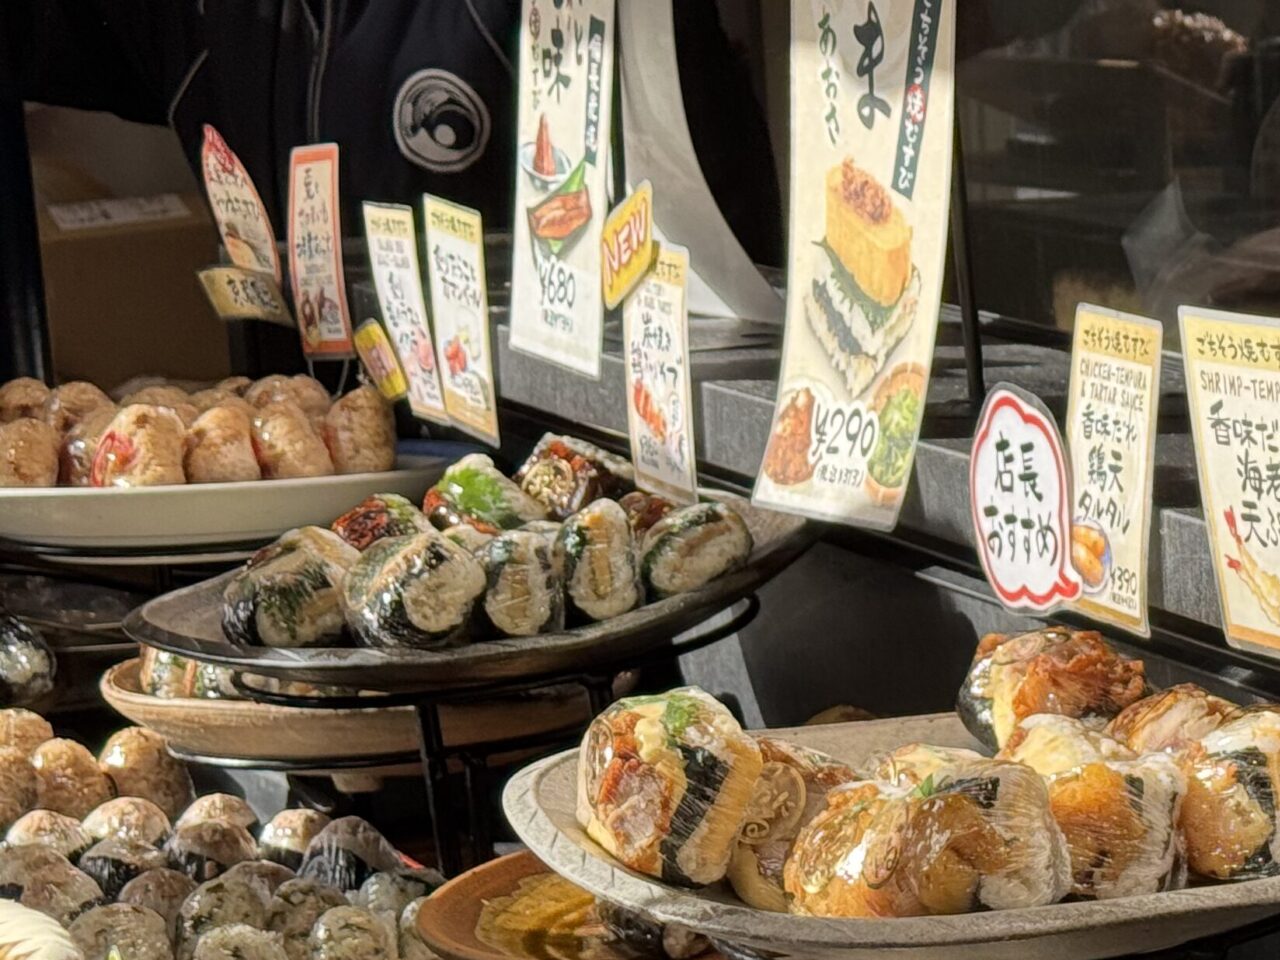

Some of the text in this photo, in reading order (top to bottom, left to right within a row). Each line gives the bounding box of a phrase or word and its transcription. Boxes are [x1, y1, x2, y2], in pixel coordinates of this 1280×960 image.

[602, 196, 648, 291] NEW
[539, 263, 576, 309] ¥680
[811, 403, 875, 457] ¥290
[1082, 403, 1138, 449] 香味だれ
[994, 430, 1044, 502] 店長
[983, 494, 1059, 568] おすすめ
[1078, 489, 1130, 535] タルタル
[1109, 566, 1138, 596] ¥390
